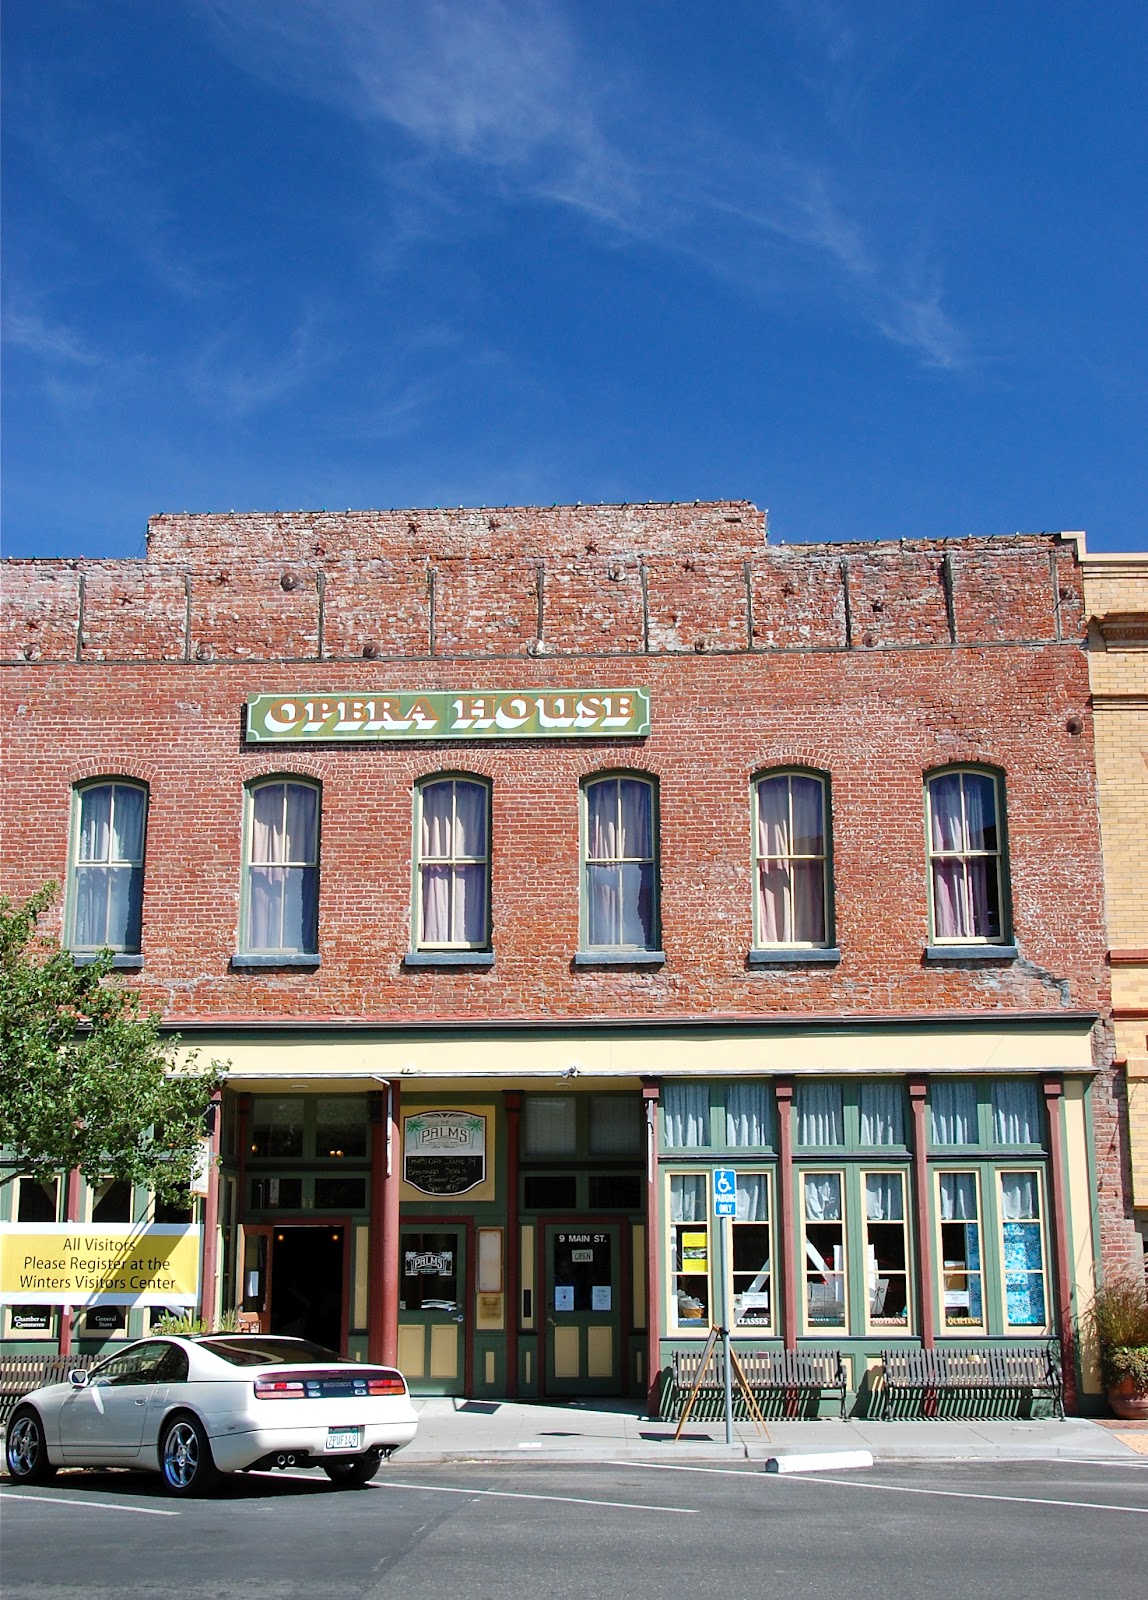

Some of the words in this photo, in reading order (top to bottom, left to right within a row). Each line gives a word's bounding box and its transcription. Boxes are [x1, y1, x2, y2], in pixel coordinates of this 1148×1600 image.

[266, 697, 439, 731] OPERA
[452, 694, 636, 729] HOUSE
[421, 1126, 468, 1143] PALMS
[718, 1203, 733, 1214] ONLY
[62, 1237, 81, 1251] All
[84, 1237, 136, 1252] Visitors
[558, 1234, 566, 1243] 9
[568, 1234, 591, 1243] MAIN
[593, 1234, 608, 1243] ST.
[414, 1256, 443, 1269] PALMS
[574, 1252, 592, 1261] OPEN
[24, 1256, 66, 1270] Please
[70, 1256, 127, 1273] Register
[130, 1258, 145, 1270] at
[147, 1257, 171, 1271] the
[20, 1275, 71, 1289] Winters
[75, 1275, 126, 1289] Visitors
[130, 1275, 176, 1290] Center
[737, 1317, 768, 1325] CLASSES
[872, 1317, 906, 1325] NOTIONS
[947, 1317, 981, 1325] QUILTING
[328, 1434, 357, 1446] 2PUF149
